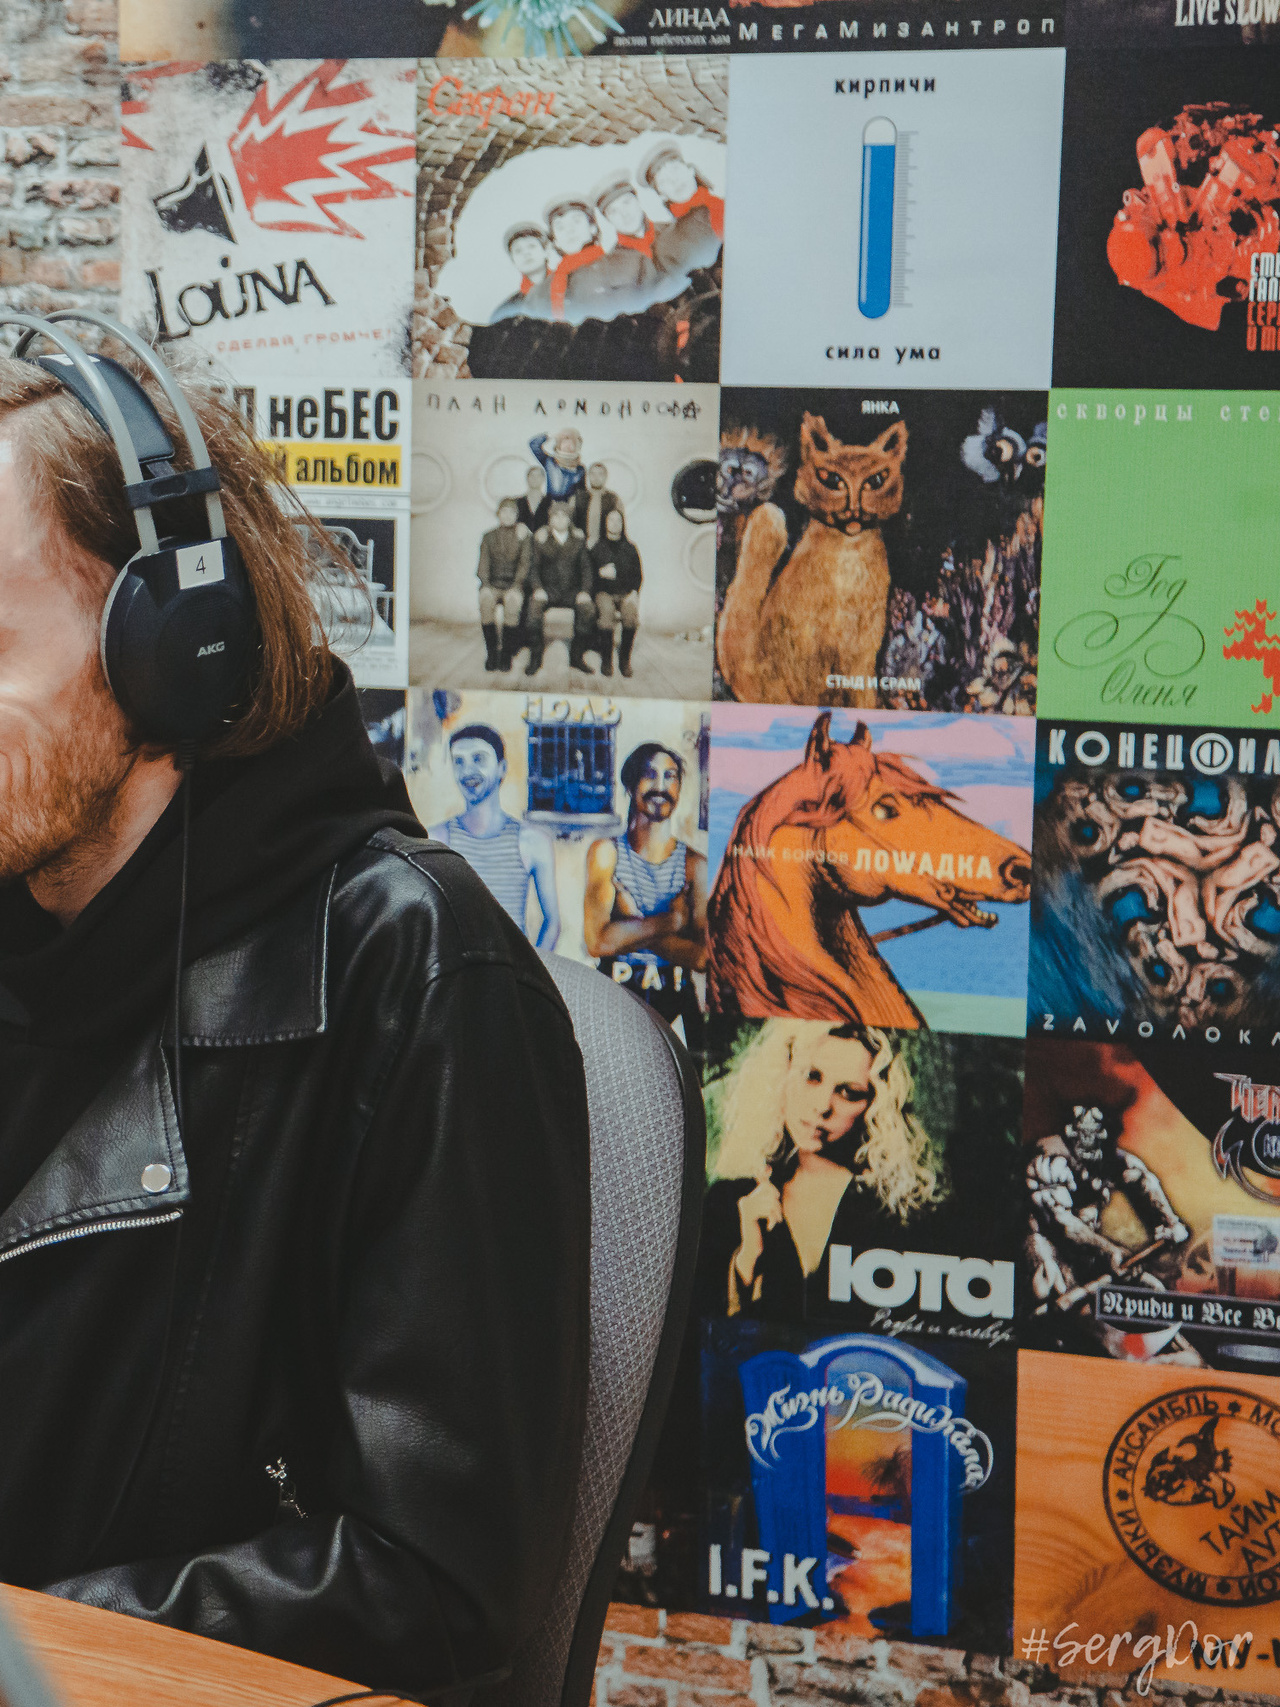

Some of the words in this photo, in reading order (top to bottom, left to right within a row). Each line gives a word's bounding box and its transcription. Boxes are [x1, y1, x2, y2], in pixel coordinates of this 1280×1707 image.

[648, 7, 731, 31] ЛИНДА
[834, 75, 936, 99] кирпичи
[427, 76, 556, 129] Секрет
[1247, 301, 1280, 326] СЕР
[217, 335, 294, 352] СДЕЛАЙ
[825, 344, 881, 361] сила
[895, 345, 941, 364] ума
[427, 393, 507, 414] ПЛАН
[861, 400, 900, 415] ЯНКА
[1056, 402, 1193, 425] скворцы
[1220, 404, 1280, 422] сте
[296, 453, 397, 485] альбом
[195, 555, 206, 574] 4
[197, 641, 225, 657] AKG
[825, 675, 865, 691] СТЫД
[867, 676, 879, 689] И
[880, 676, 921, 691] СРАМ
[1113, 1393, 1219, 1481] АНСАМБЛЬ
[1116, 1508, 1208, 1596] МУЗЫКИ
[709, 1543, 835, 1611] I.F.K.
